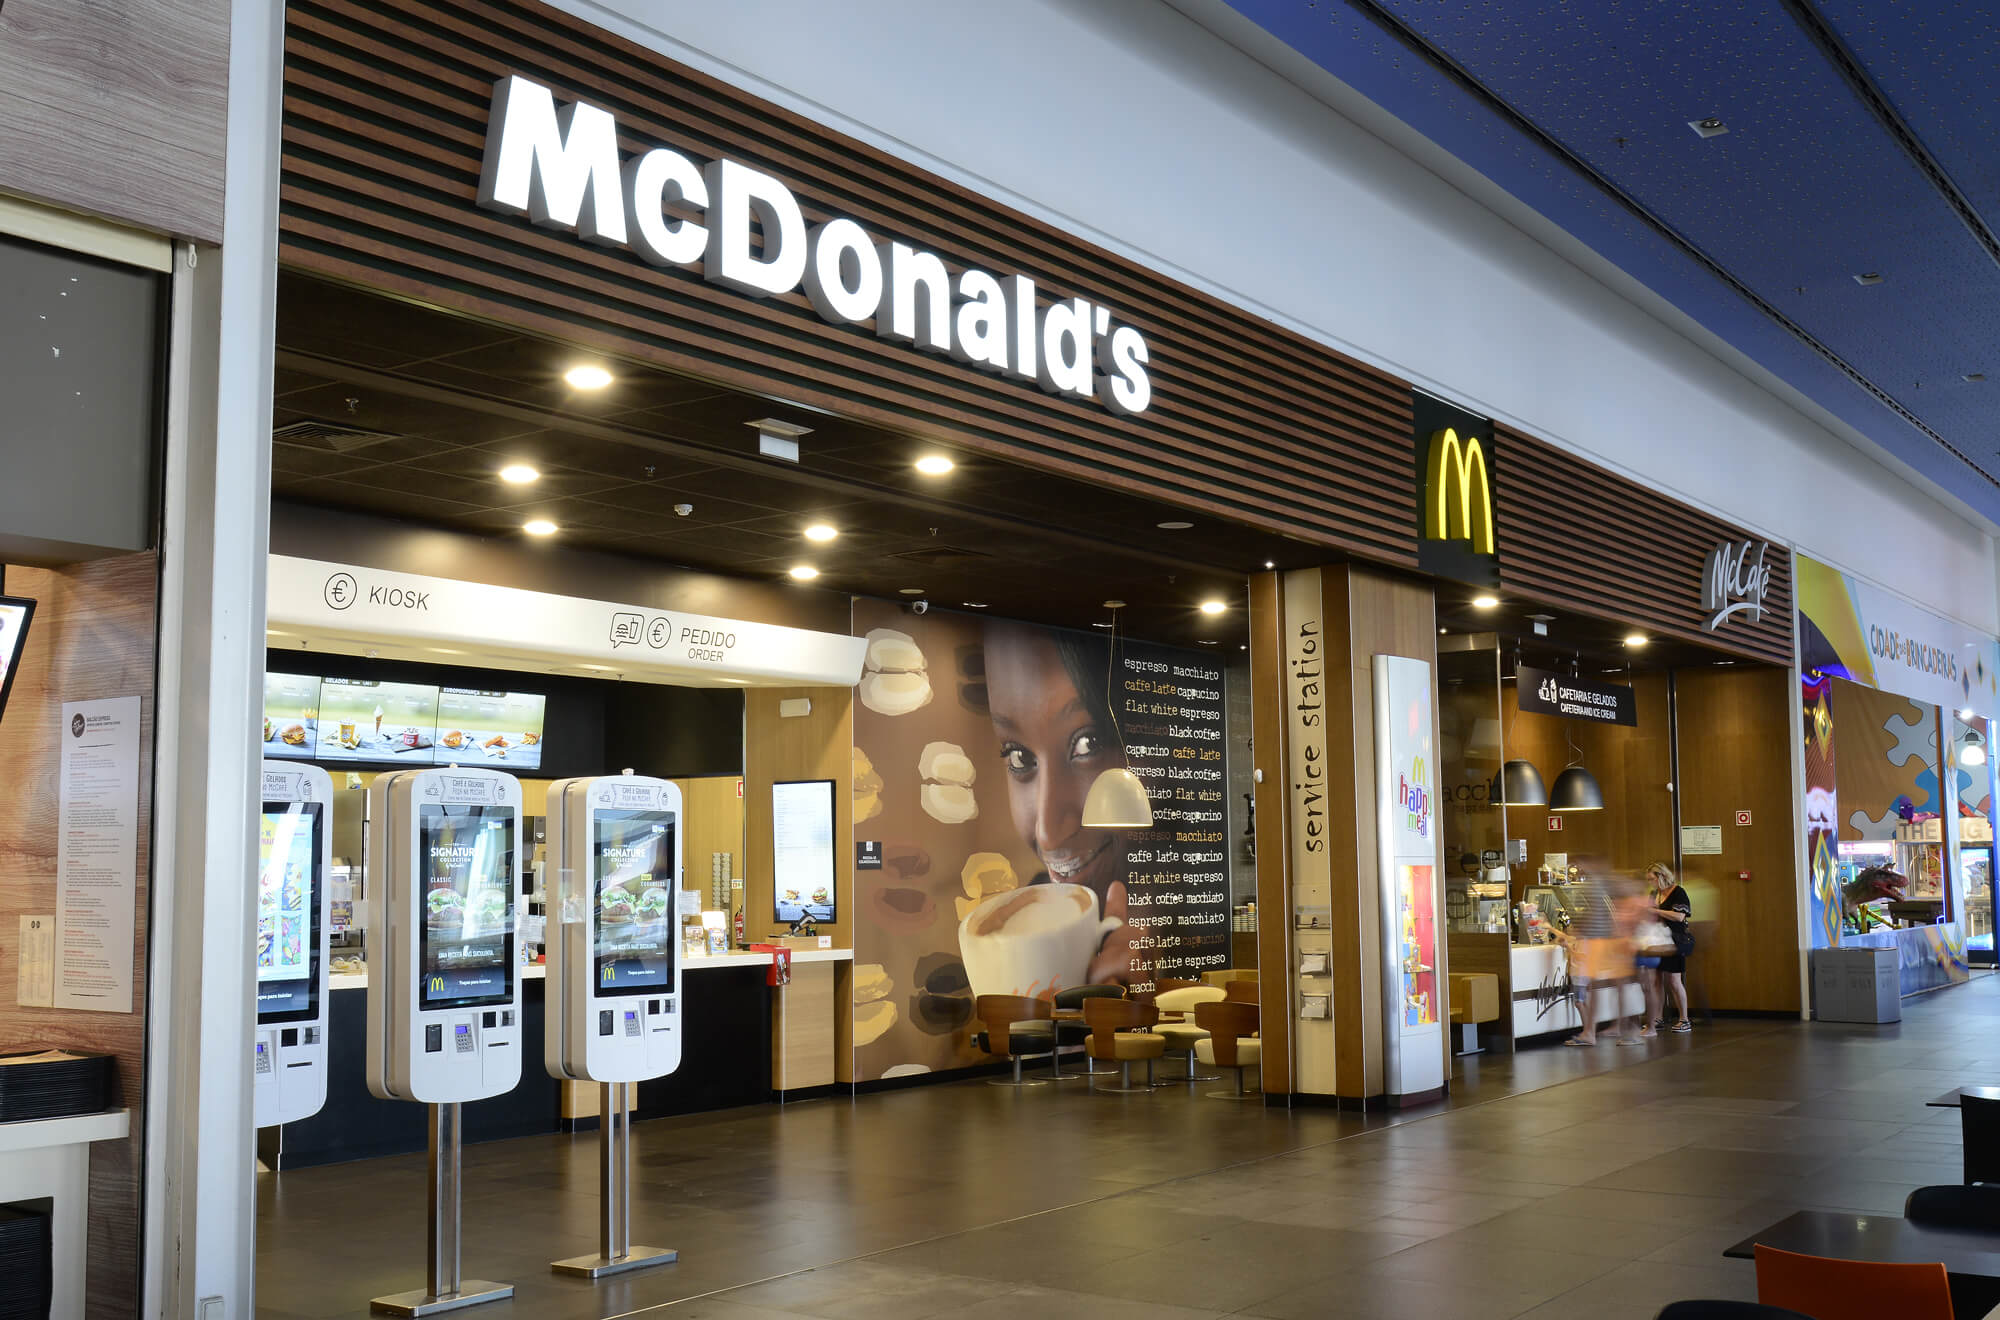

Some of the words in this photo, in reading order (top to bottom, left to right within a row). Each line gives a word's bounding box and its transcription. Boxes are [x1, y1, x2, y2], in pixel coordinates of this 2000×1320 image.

[486, 75, 1150, 413] McDonald's
[1706, 540, 1771, 630] McCafé
[368, 585, 430, 611] KIOSK
[680, 628, 736, 650] PEDIDO
[688, 648, 724, 663] ORDER
[1871, 623, 1900, 660] CIDADE
[1906, 638, 1957, 682] BRINCADEIRAS
[1124, 657, 1168, 673] espresso
[1173, 664, 1219, 681] macchiato
[1292, 620, 1321, 727] station
[1124, 679, 1151, 691] caffe
[1152, 681, 1176, 695] latte
[1559, 687, 1588, 703] CAFETARIA
[1592, 693, 1617, 708] GELADOS
[1125, 699, 1149, 714] flat
[1151, 704, 1178, 716] white
[1180, 706, 1220, 721] espresso
[1600, 709, 1616, 720] CREAM
[1169, 725, 1193, 738] black
[1193, 728, 1221, 740] coffee
[1172, 747, 1196, 759] caffe
[1199, 748, 1221, 760] latte
[1168, 766, 1193, 779] black
[1193, 768, 1222, 781] coffee
[1145, 785, 1172, 799] hiato
[1175, 787, 1195, 801] flat
[1198, 789, 1222, 802] white
[1296, 745, 1324, 853] service
[1399, 774, 1433, 820] happy
[1152, 808, 1182, 821] coffee
[1408, 814, 1428, 837] meal
[1176, 831, 1223, 843] macchiato
[1127, 849, 1152, 863] caffe
[1156, 850, 1179, 862] latte
[1128, 871, 1151, 884] flat
[1153, 871, 1181, 884] white
[1183, 871, 1224, 885] espresso
[1128, 893, 1152, 906] black
[1156, 893, 1184, 905] coffee
[1186, 892, 1224, 904] macchiato
[1128, 915, 1173, 930] espresso
[1178, 912, 1225, 926] macchiato
[1129, 936, 1155, 950] caffe
[1156, 935, 1181, 948] latte
[1129, 959, 1153, 972] flat
[1155, 956, 1183, 970] white
[1185, 953, 1226, 968] espresso
